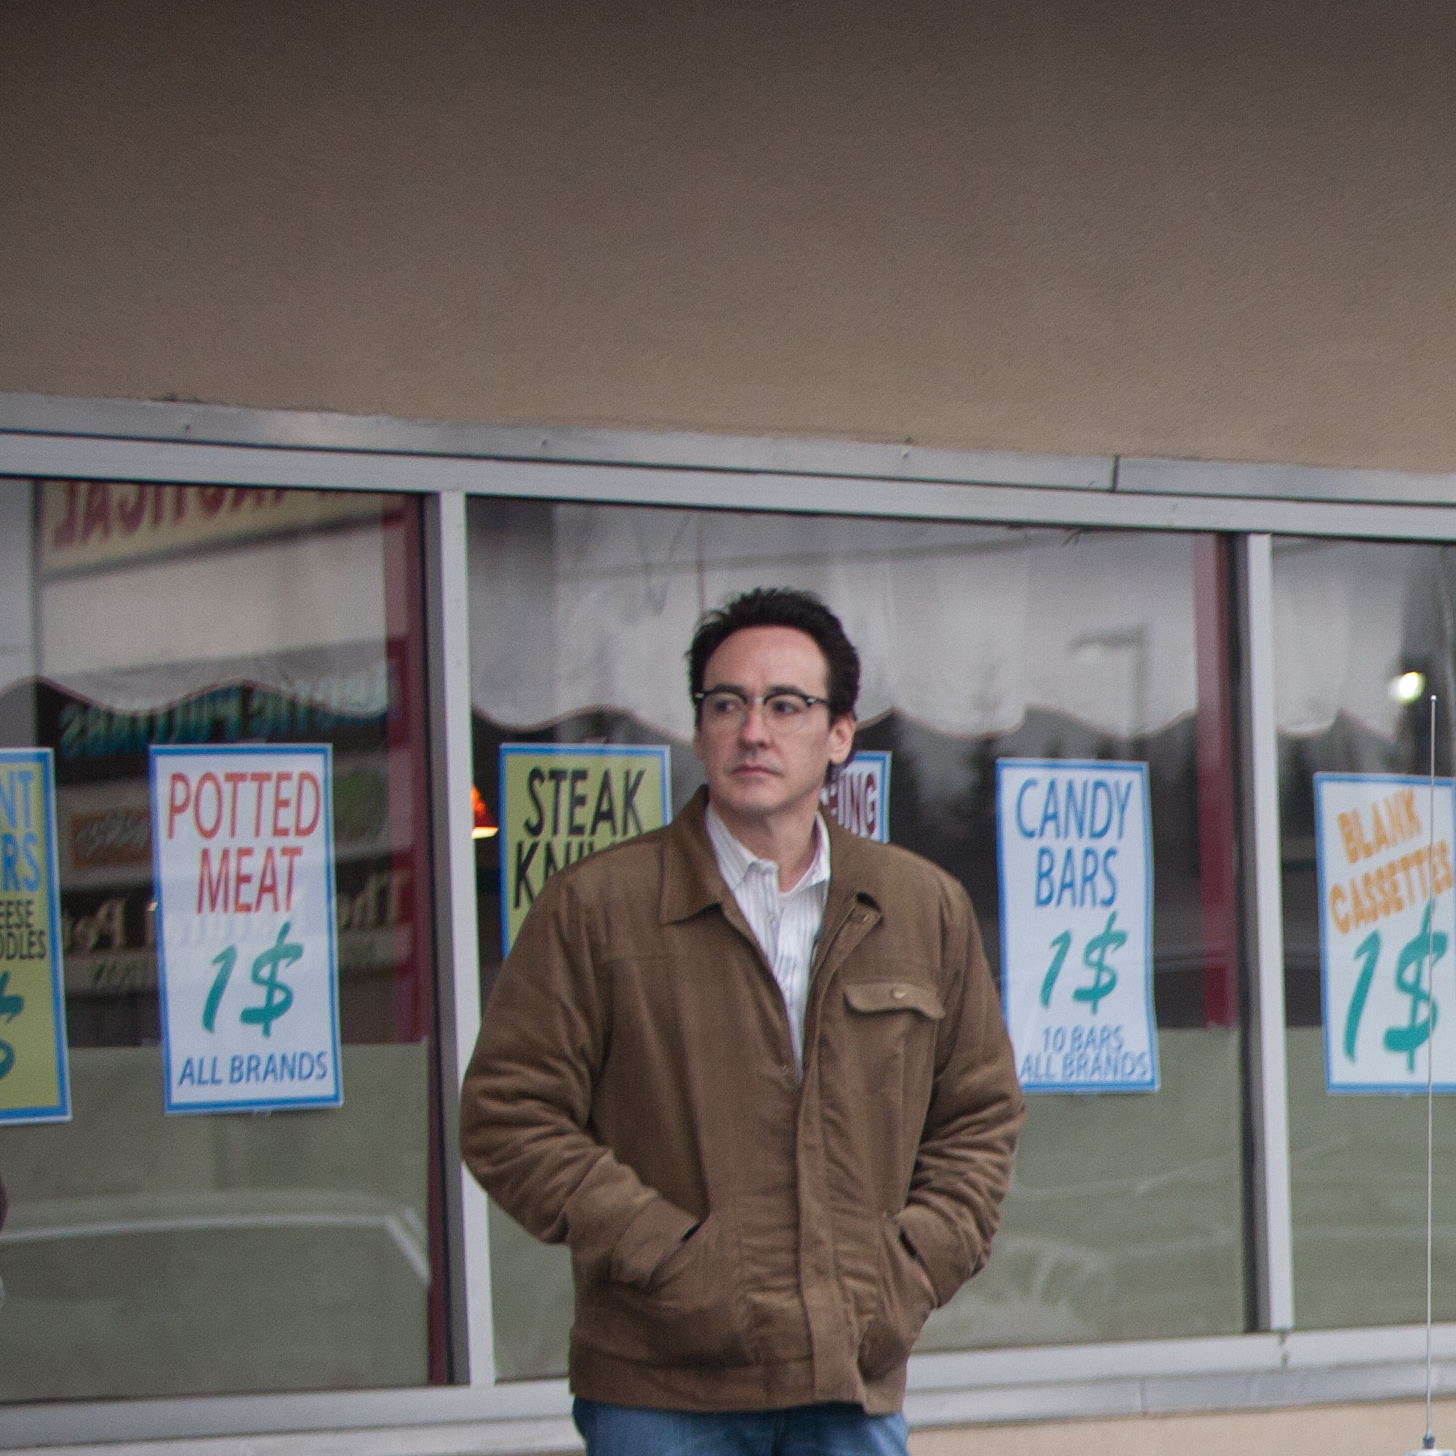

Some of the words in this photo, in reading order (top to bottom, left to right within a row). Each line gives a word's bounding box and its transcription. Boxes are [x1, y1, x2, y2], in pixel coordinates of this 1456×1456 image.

[167, 772, 321, 839] POTTED
[523, 769, 646, 837] STEAK
[1015, 777, 1134, 840] CANDY
[1337, 786, 1422, 864] BLANK
[196, 847, 302, 915] MEAT
[1035, 846, 1117, 908] BARS
[1330, 840, 1454, 935] CASSETTES
[179, 1058, 222, 1086] ALL
[230, 1051, 328, 1084] BRANDS
[1020, 1055, 1059, 1079] ALL
[1065, 1051, 1151, 1079] BRANDS
[1042, 1027, 1065, 1051] 10
[1072, 1024, 1124, 1050] BARS
